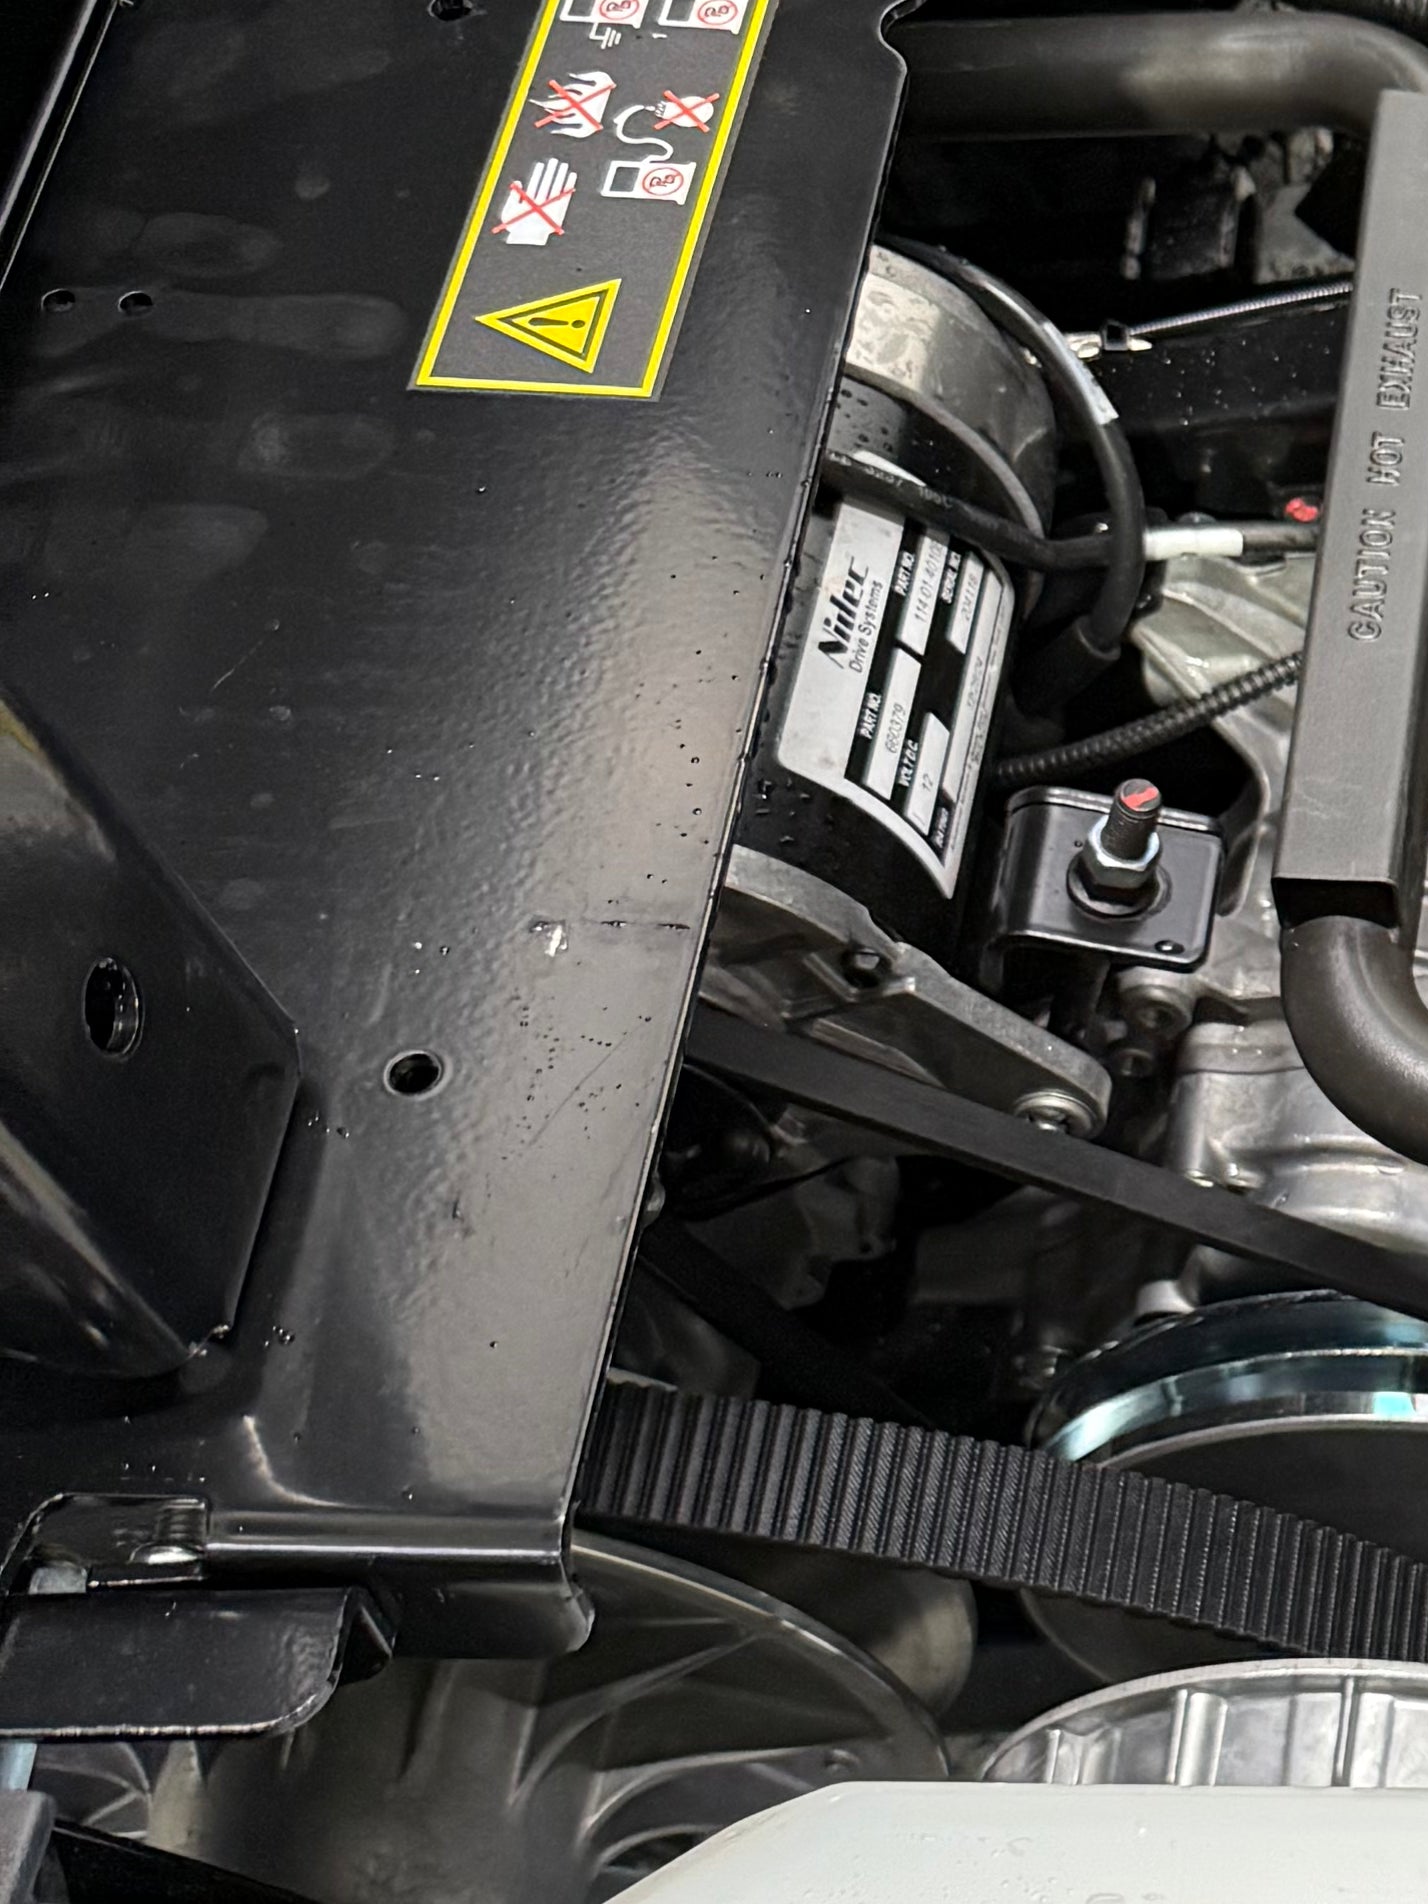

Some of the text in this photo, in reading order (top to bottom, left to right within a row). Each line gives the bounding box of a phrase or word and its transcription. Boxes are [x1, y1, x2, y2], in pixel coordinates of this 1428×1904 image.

[1347, 287, 1422, 642] CAUTION HOT EXHAUST
[816, 555, 870, 669] Nidec
[893, 569, 911, 596] PART
[848, 580, 883, 674] Drive Systems
[860, 710, 879, 739] PART
[921, 773, 934, 792] 12
